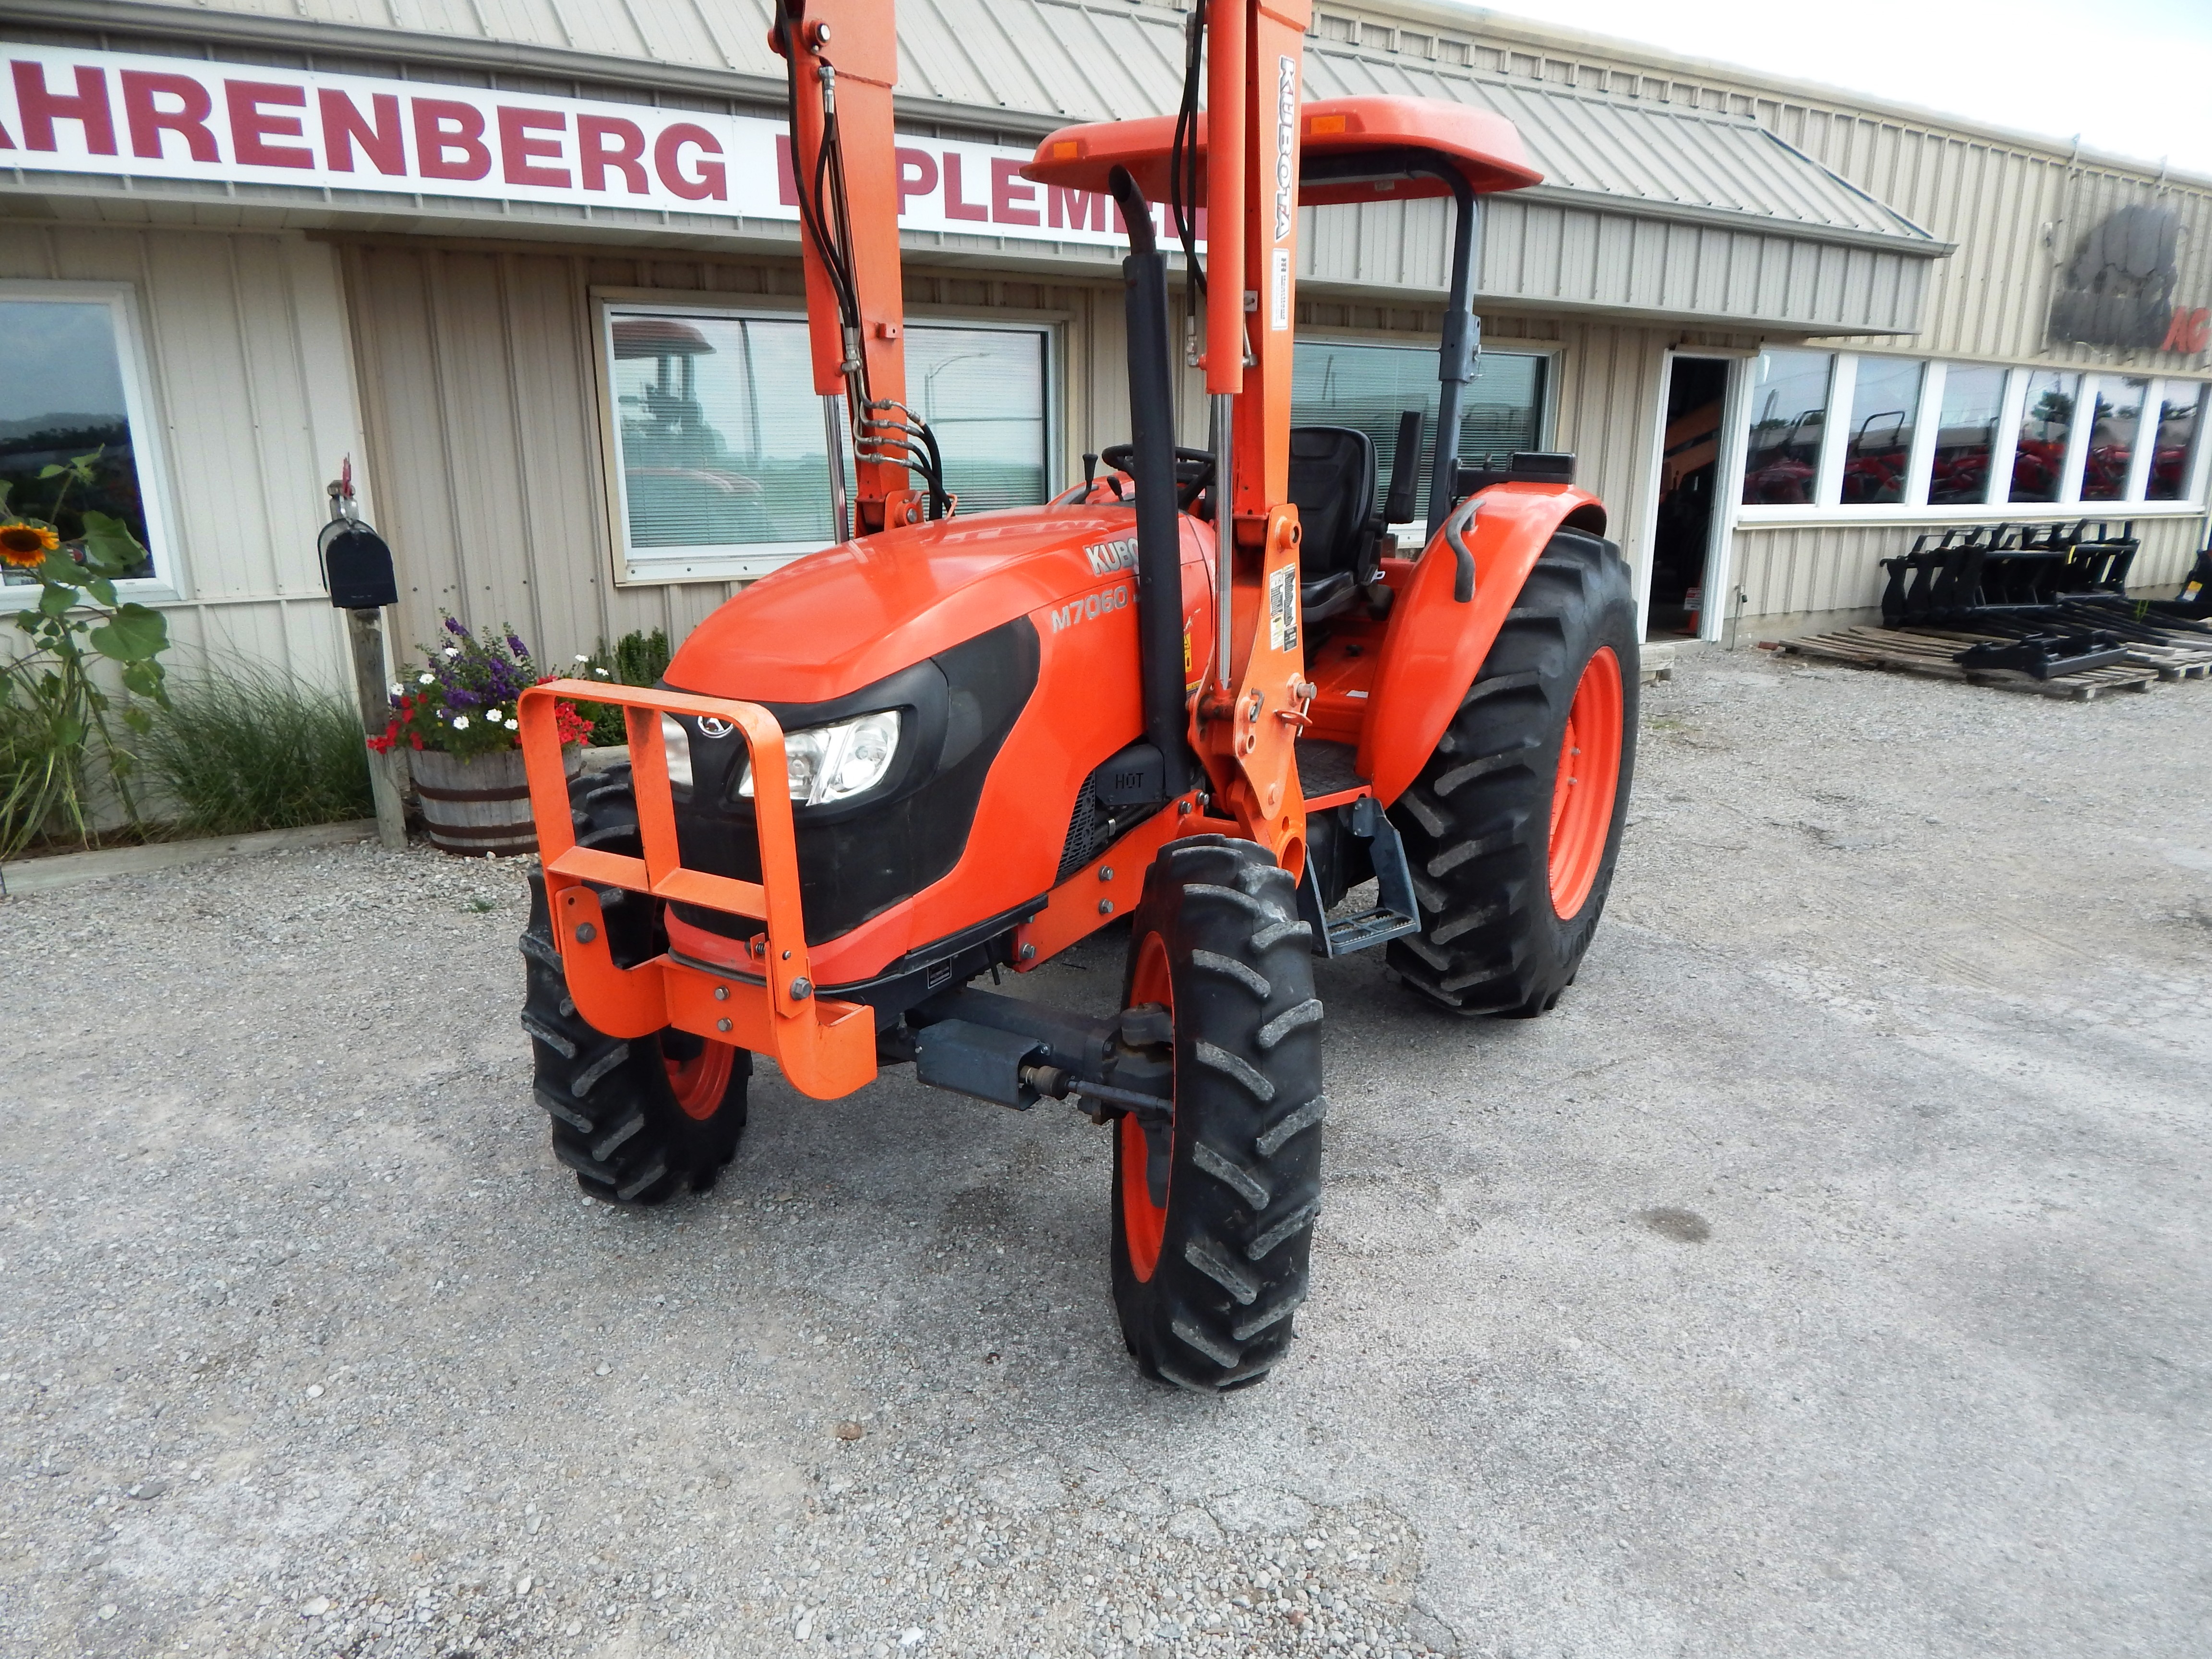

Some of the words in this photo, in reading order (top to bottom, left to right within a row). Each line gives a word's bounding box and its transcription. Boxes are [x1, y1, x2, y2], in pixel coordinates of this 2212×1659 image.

[0, 60, 727, 201] HRENBERG
[776, 133, 1208, 241] IPLEM
[1274, 55, 1296, 241] KUBOTA
[1051, 585, 1128, 633] M7060
[1116, 772, 1144, 789] HOT
